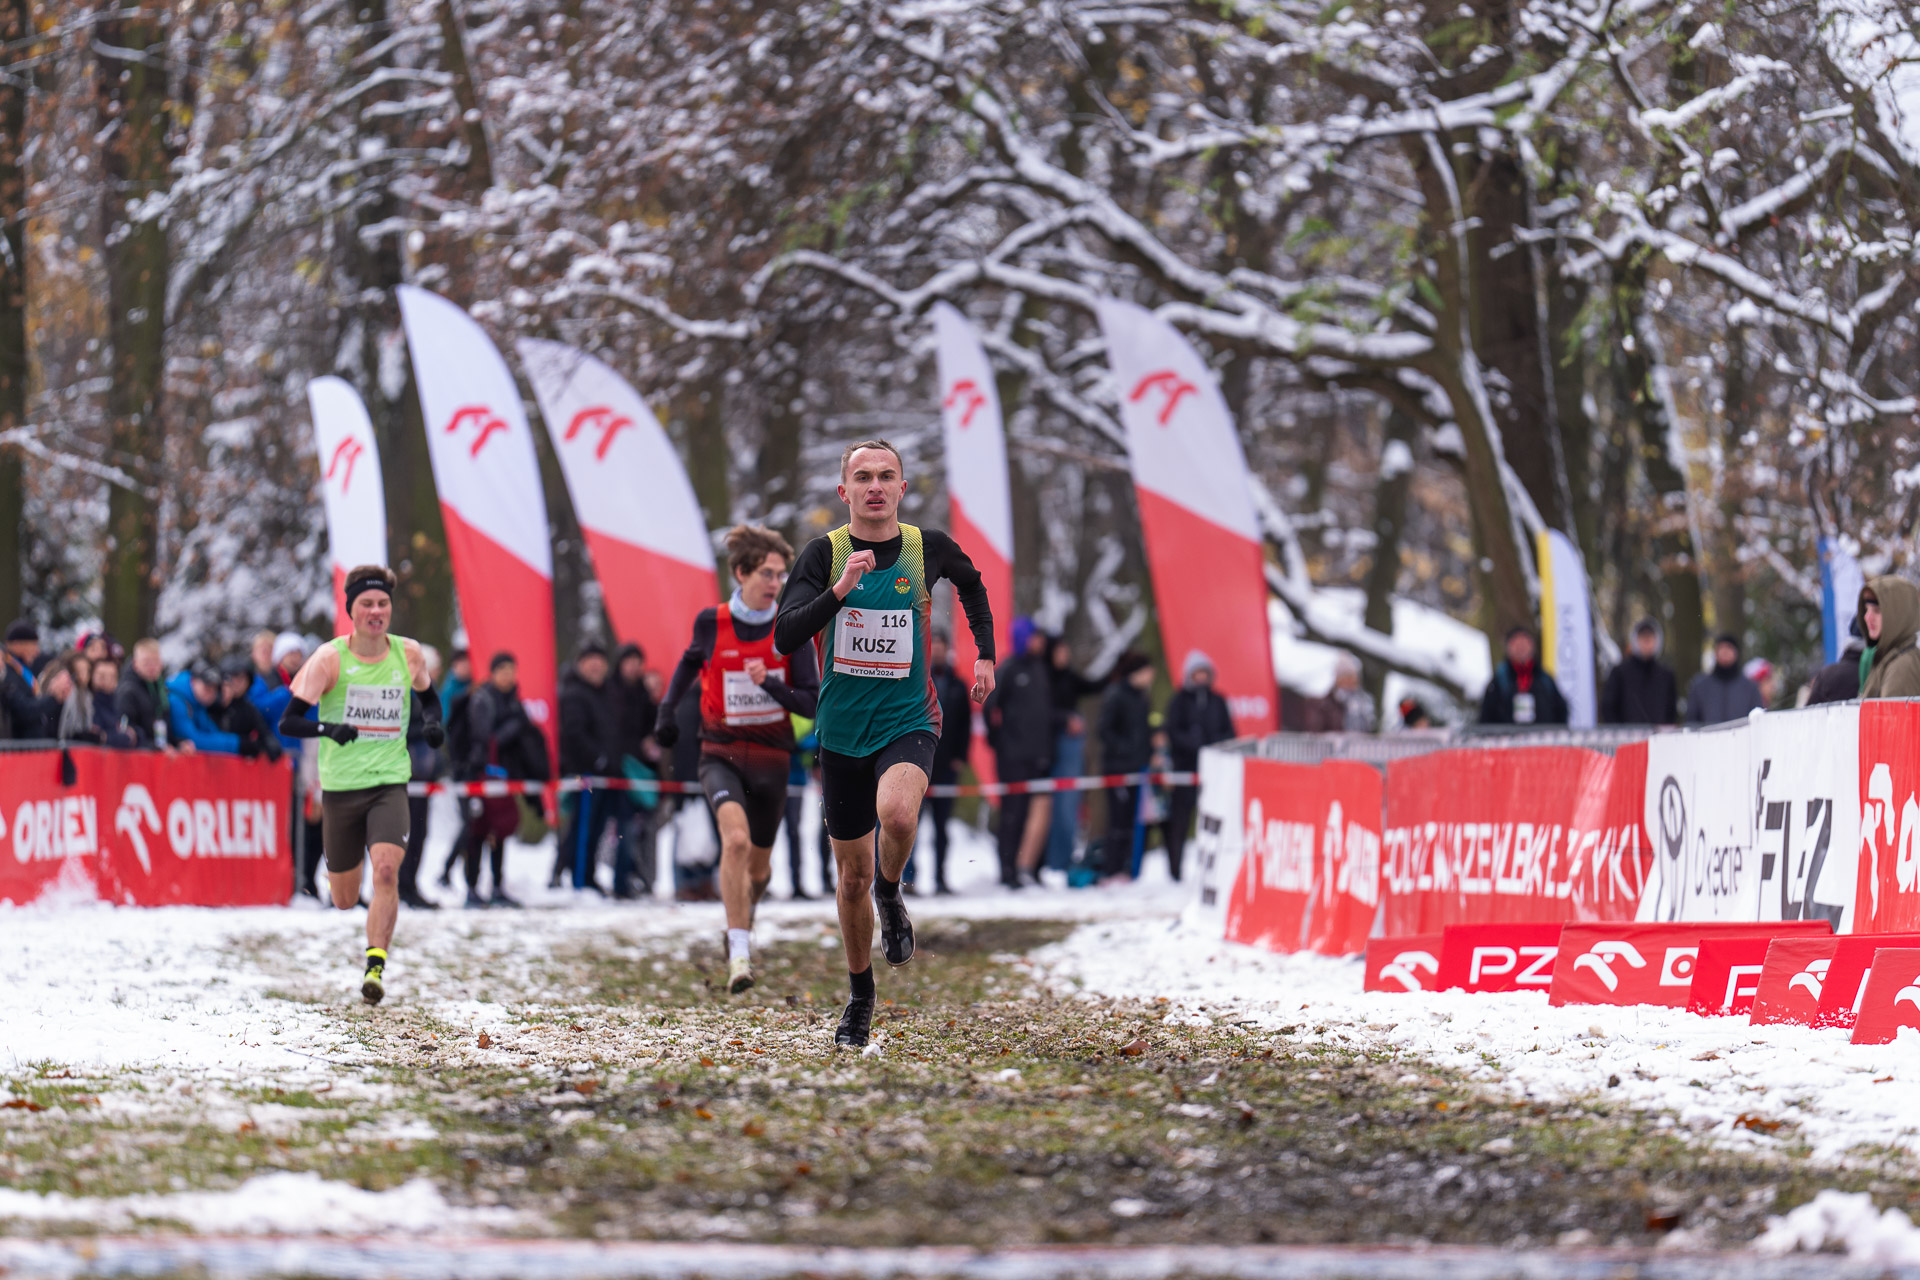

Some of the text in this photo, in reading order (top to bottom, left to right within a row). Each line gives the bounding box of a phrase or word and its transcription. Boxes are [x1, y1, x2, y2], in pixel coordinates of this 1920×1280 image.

[881, 614, 907, 628] 116
[852, 636, 896, 654] KUSZ
[850, 667, 894, 677] BYTOM 2024
[381, 689, 401, 700] 157
[346, 704, 400, 720] ZAWIŚLAK
[167, 797, 277, 859] ORLEN
